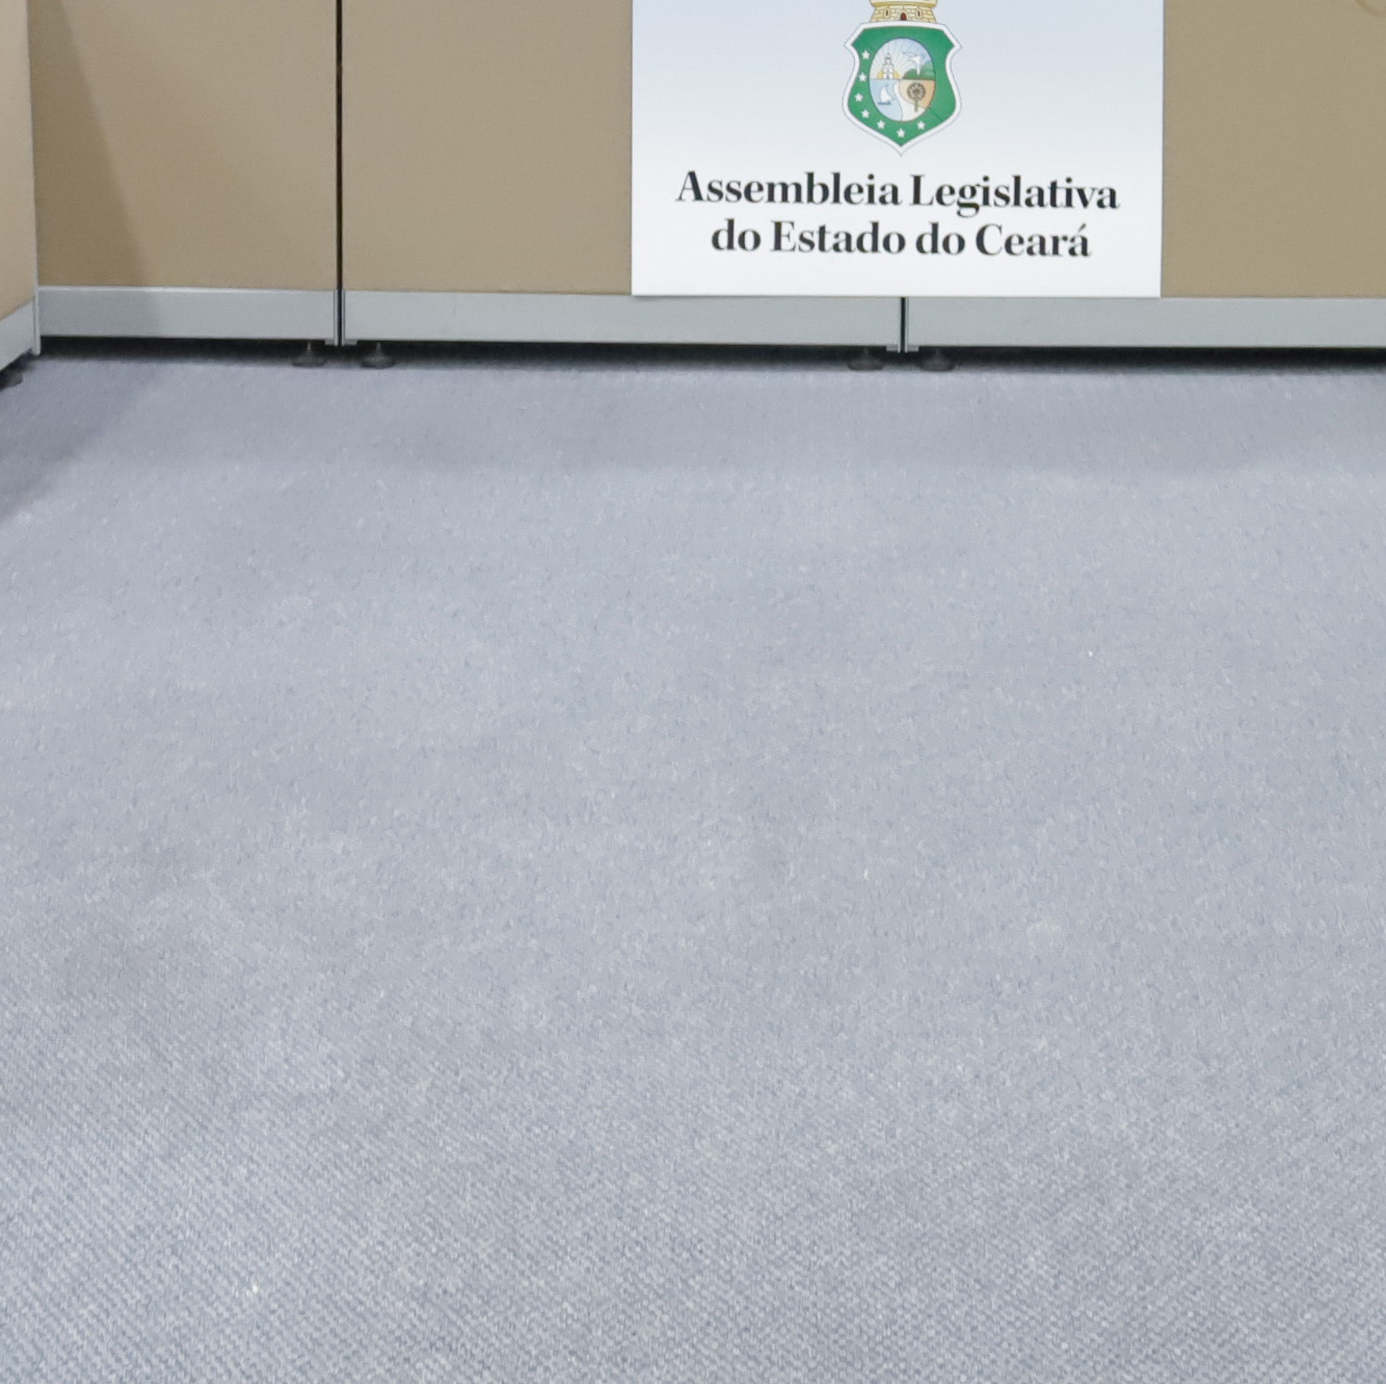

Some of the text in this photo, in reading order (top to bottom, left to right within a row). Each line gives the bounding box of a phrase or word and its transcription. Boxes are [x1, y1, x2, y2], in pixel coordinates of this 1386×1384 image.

[677, 170, 1120, 218] Assembleia Legislativa
[711, 218, 1091, 258] do Estado do Ceará
